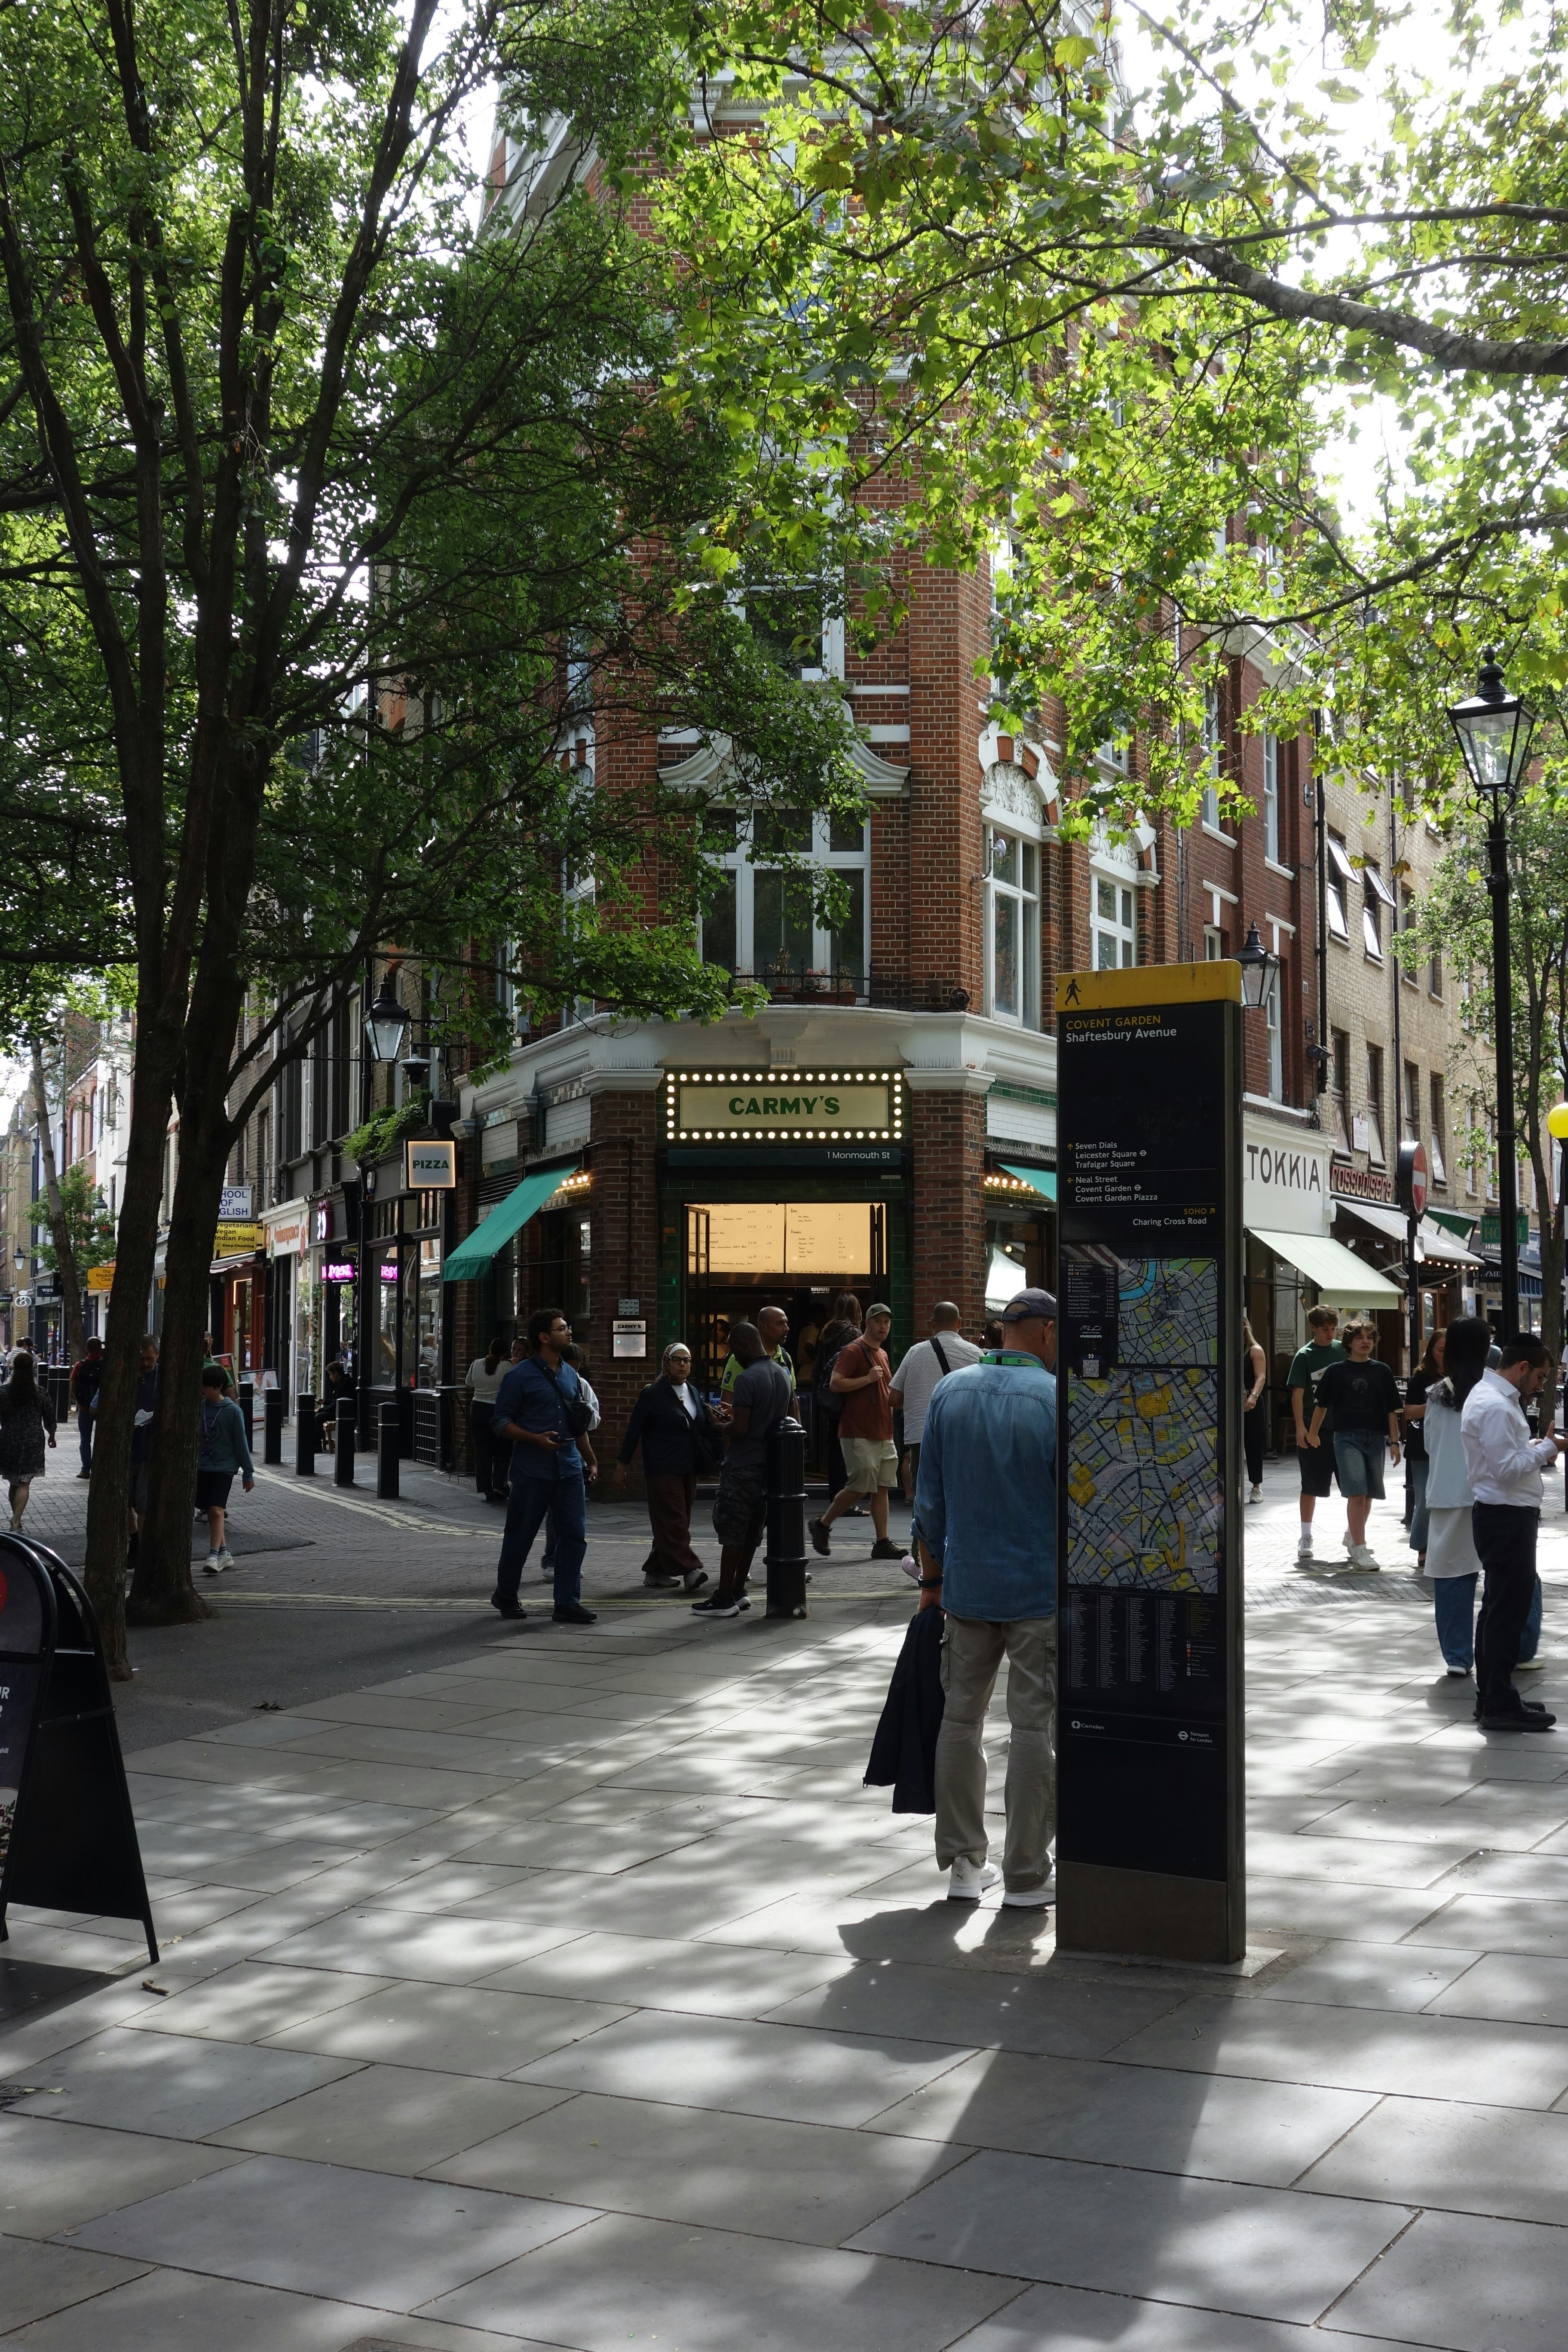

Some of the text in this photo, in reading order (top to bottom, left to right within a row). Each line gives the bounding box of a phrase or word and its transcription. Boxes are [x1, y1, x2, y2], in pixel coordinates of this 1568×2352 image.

[1066, 1015, 1161, 1029] COVENT GARDEN
[1066, 1028, 1177, 1043] Shaftesbury Avenue
[729, 1095, 840, 1115] CARMY'S
[832, 1151, 880, 1159] Monmouth
[1112, 1151, 1137, 1159] Square
[412, 1160, 450, 1169] PIZZA
[1075, 1160, 1136, 1169] Trafalgar Square
[1246, 1143, 1321, 1193] TOKKIA
[1133, 1218, 1162, 1227] Charing
